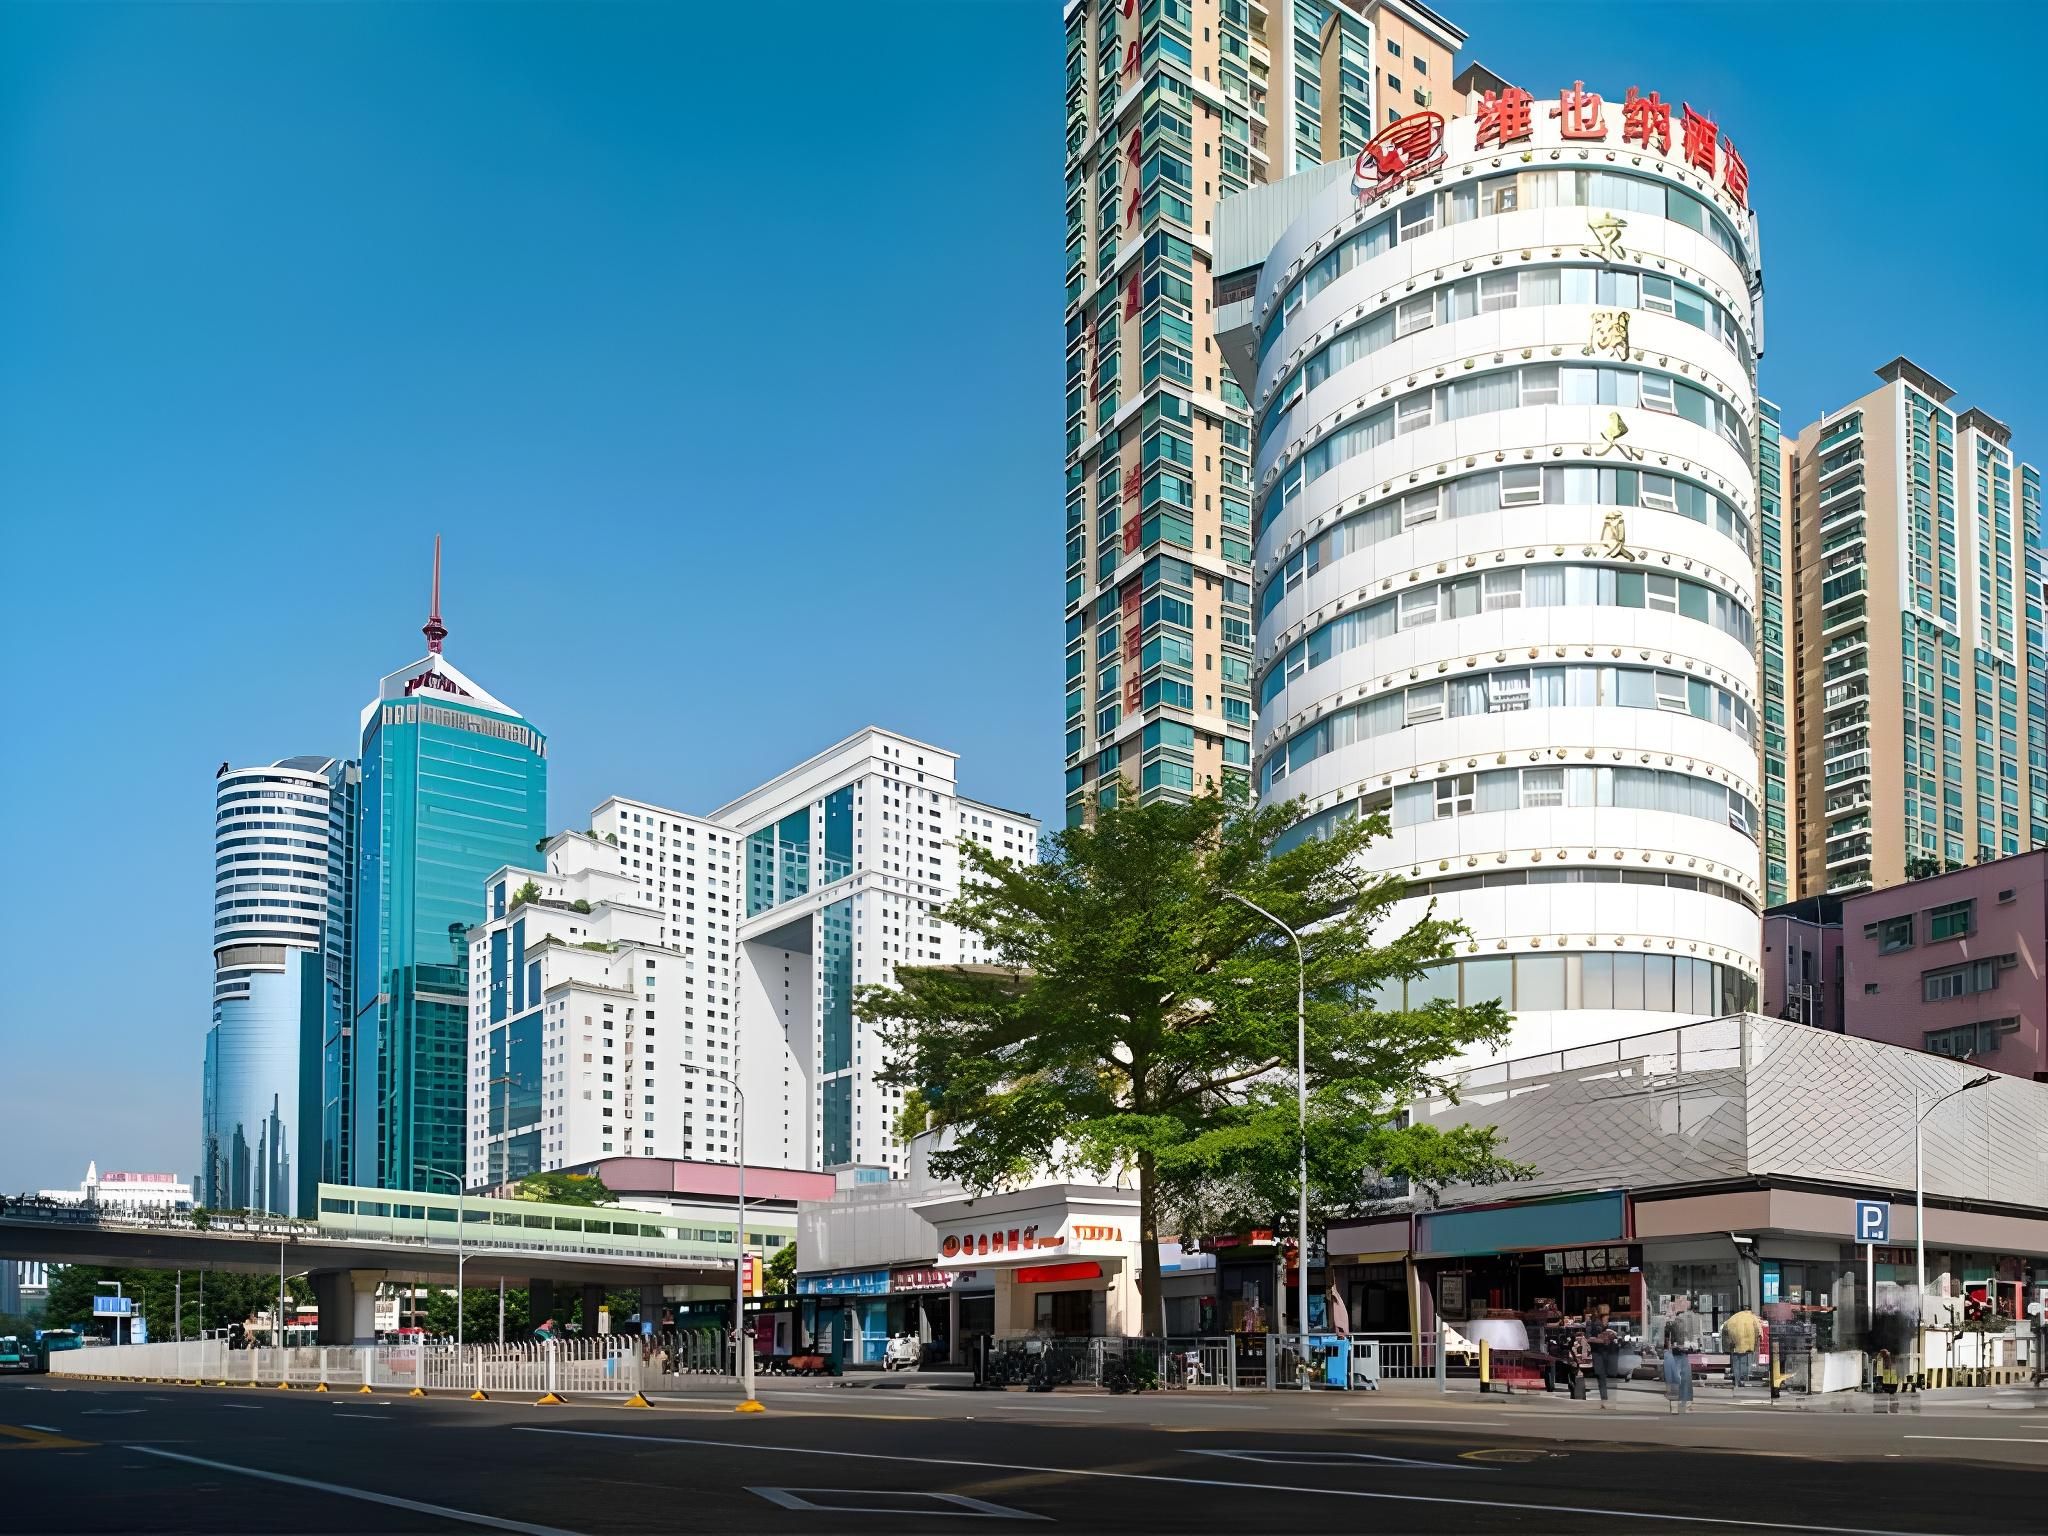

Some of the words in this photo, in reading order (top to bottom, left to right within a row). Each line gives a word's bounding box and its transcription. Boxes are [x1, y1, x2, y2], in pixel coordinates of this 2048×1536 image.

[1475, 80, 1749, 211] 维也纳酒店
[1863, 1206, 1882, 1238] P
